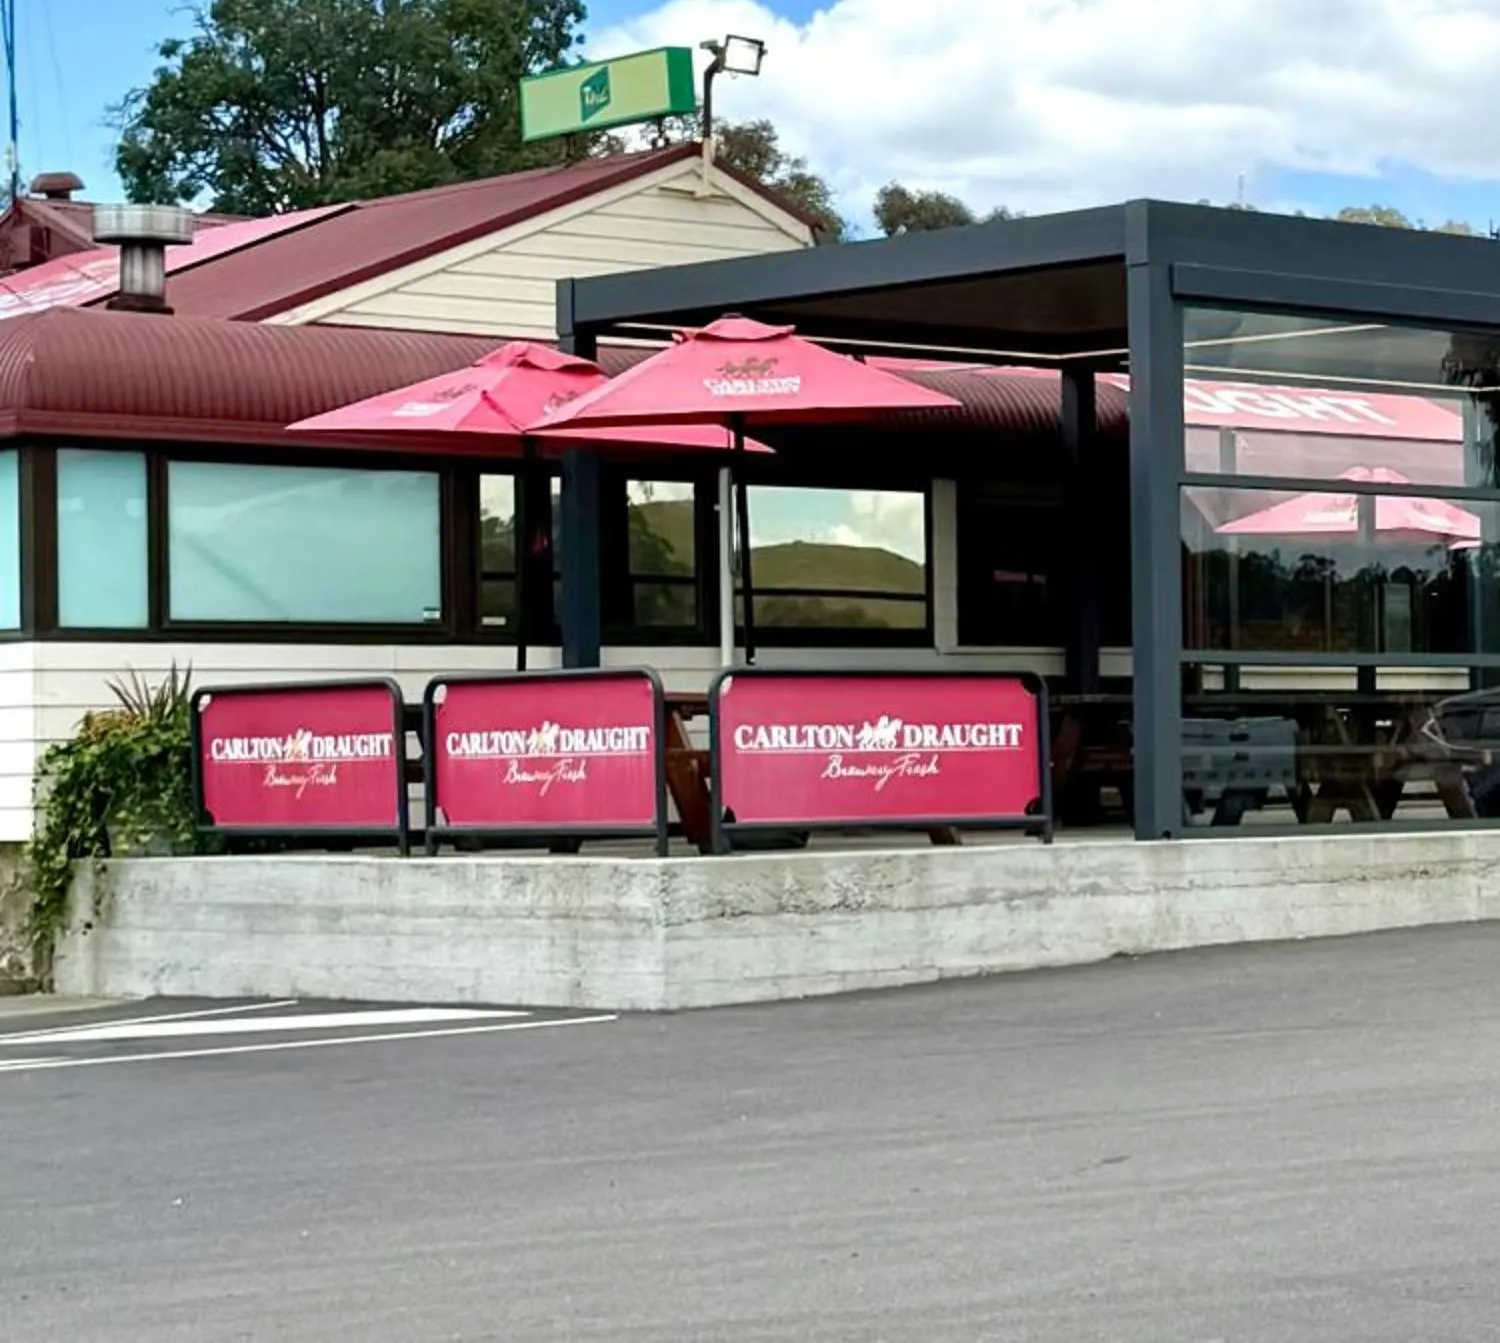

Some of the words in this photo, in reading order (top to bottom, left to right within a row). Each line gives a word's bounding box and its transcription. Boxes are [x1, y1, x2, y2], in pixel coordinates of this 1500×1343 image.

[211, 736, 284, 760] CARLTON
[313, 733, 392, 758] DRAUGHT
[446, 730, 527, 754] CARLTON
[560, 726, 650, 751] DRAUGHT
[734, 725, 854, 749] CARLTON
[904, 723, 1023, 747] DRAUGHT
